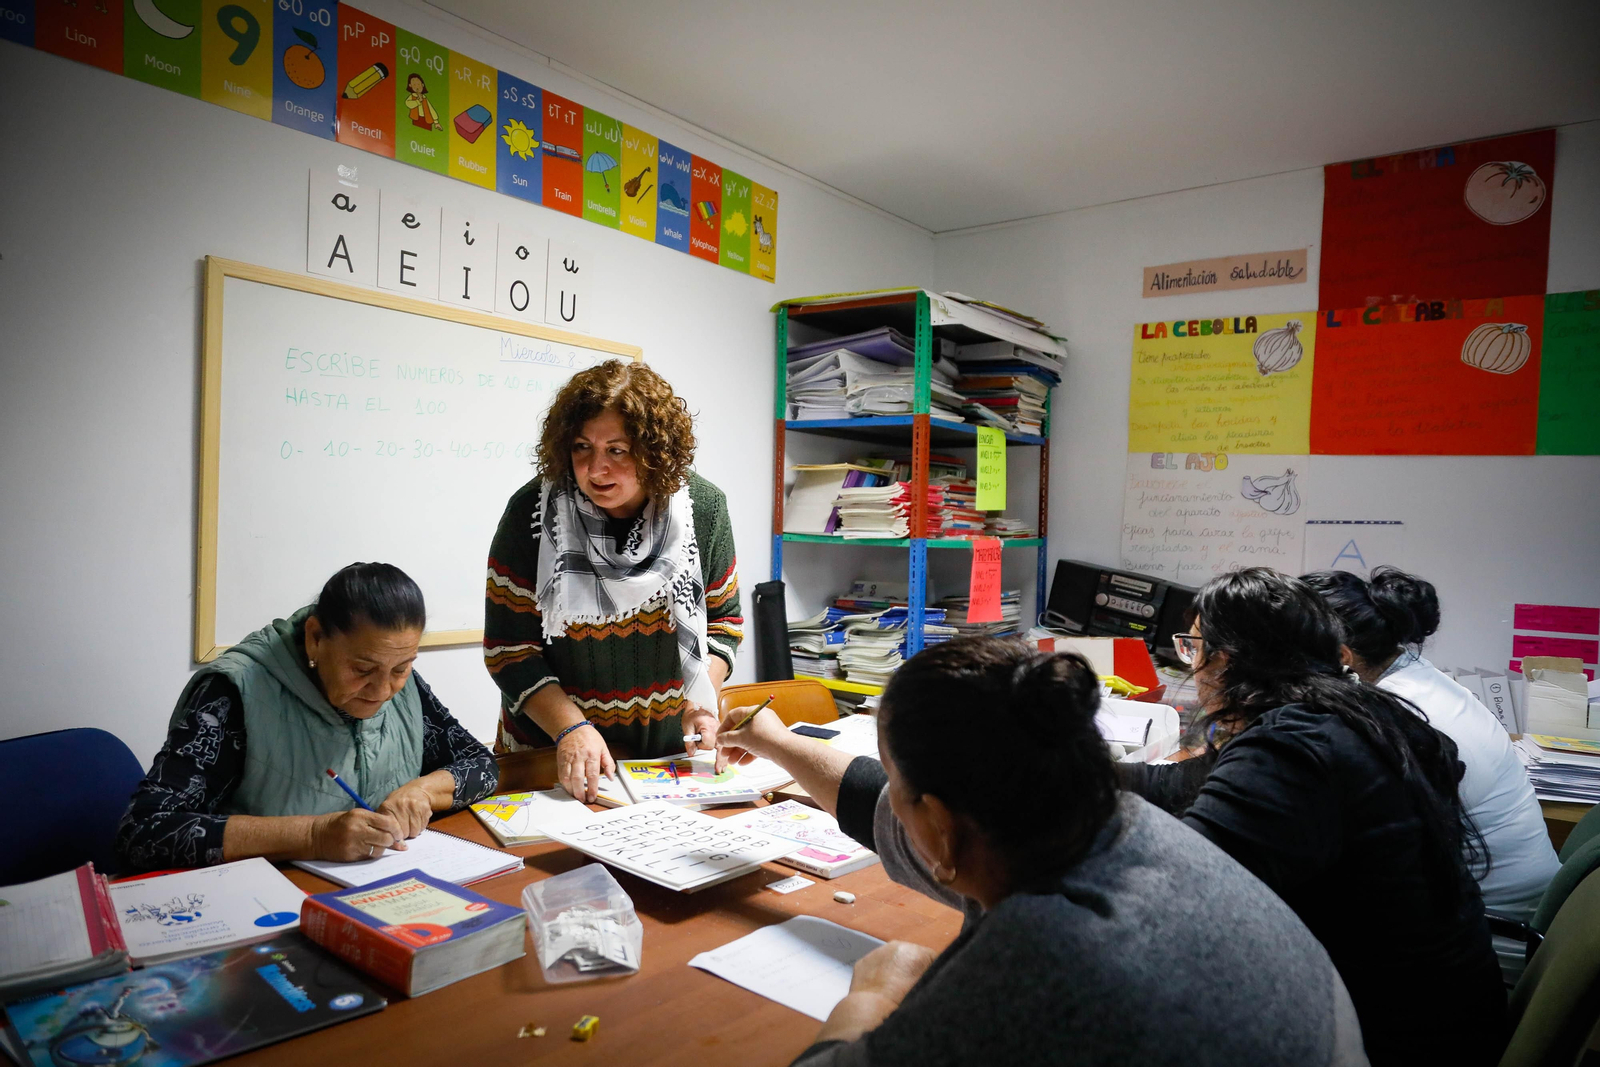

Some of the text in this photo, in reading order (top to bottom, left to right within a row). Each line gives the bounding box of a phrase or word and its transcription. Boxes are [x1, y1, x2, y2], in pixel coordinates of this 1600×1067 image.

[65, 27, 97, 48] Lion
[145, 54, 181, 76] Moon
[224, 80, 251, 97] Nine
[285, 100, 324, 122] Orange
[351, 121, 382, 140] Pencil
[410, 140, 436, 157] Quiet
[458, 156, 488, 175] Rubber
[512, 174, 528, 187] Sun
[331, 192, 357, 212] a
[554, 188, 572, 202] Train
[587, 200, 616, 217] Umbrella
[401, 212, 421, 229] e
[628, 215, 647, 228] Violin
[463, 221, 475, 245] i
[664, 227, 682, 240] Whale
[327, 234, 354, 273] A
[515, 245, 530, 260] o
[691, 237, 718, 254] Xylophone
[562, 256, 579, 274] u
[727, 250, 744, 262] Yellow
[400, 250, 418, 287] E
[462, 266, 471, 300] I
[1151, 268, 1218, 291] Alimentación
[510, 280, 530, 312] O
[560, 290, 576, 322] U
[1142, 316, 1258, 339] LA CEBOLLA
[397, 364, 464, 385] NUMEROS
[478, 373, 495, 387] DE
[504, 376, 520, 389] 10
[526, 379, 543, 392] EN
[285, 387, 447, 415] HASTA EL 100
[1151, 452, 1229, 472] EL AJO
[1137, 491, 1235, 509] funcionamiento
[1176, 507, 1222, 525] aparato
[1162, 525, 1195, 545] para
[1331, 539, 1367, 569] A
[1123, 558, 1166, 573] Bueno
[350, 883, 426, 906] AVANZADO
